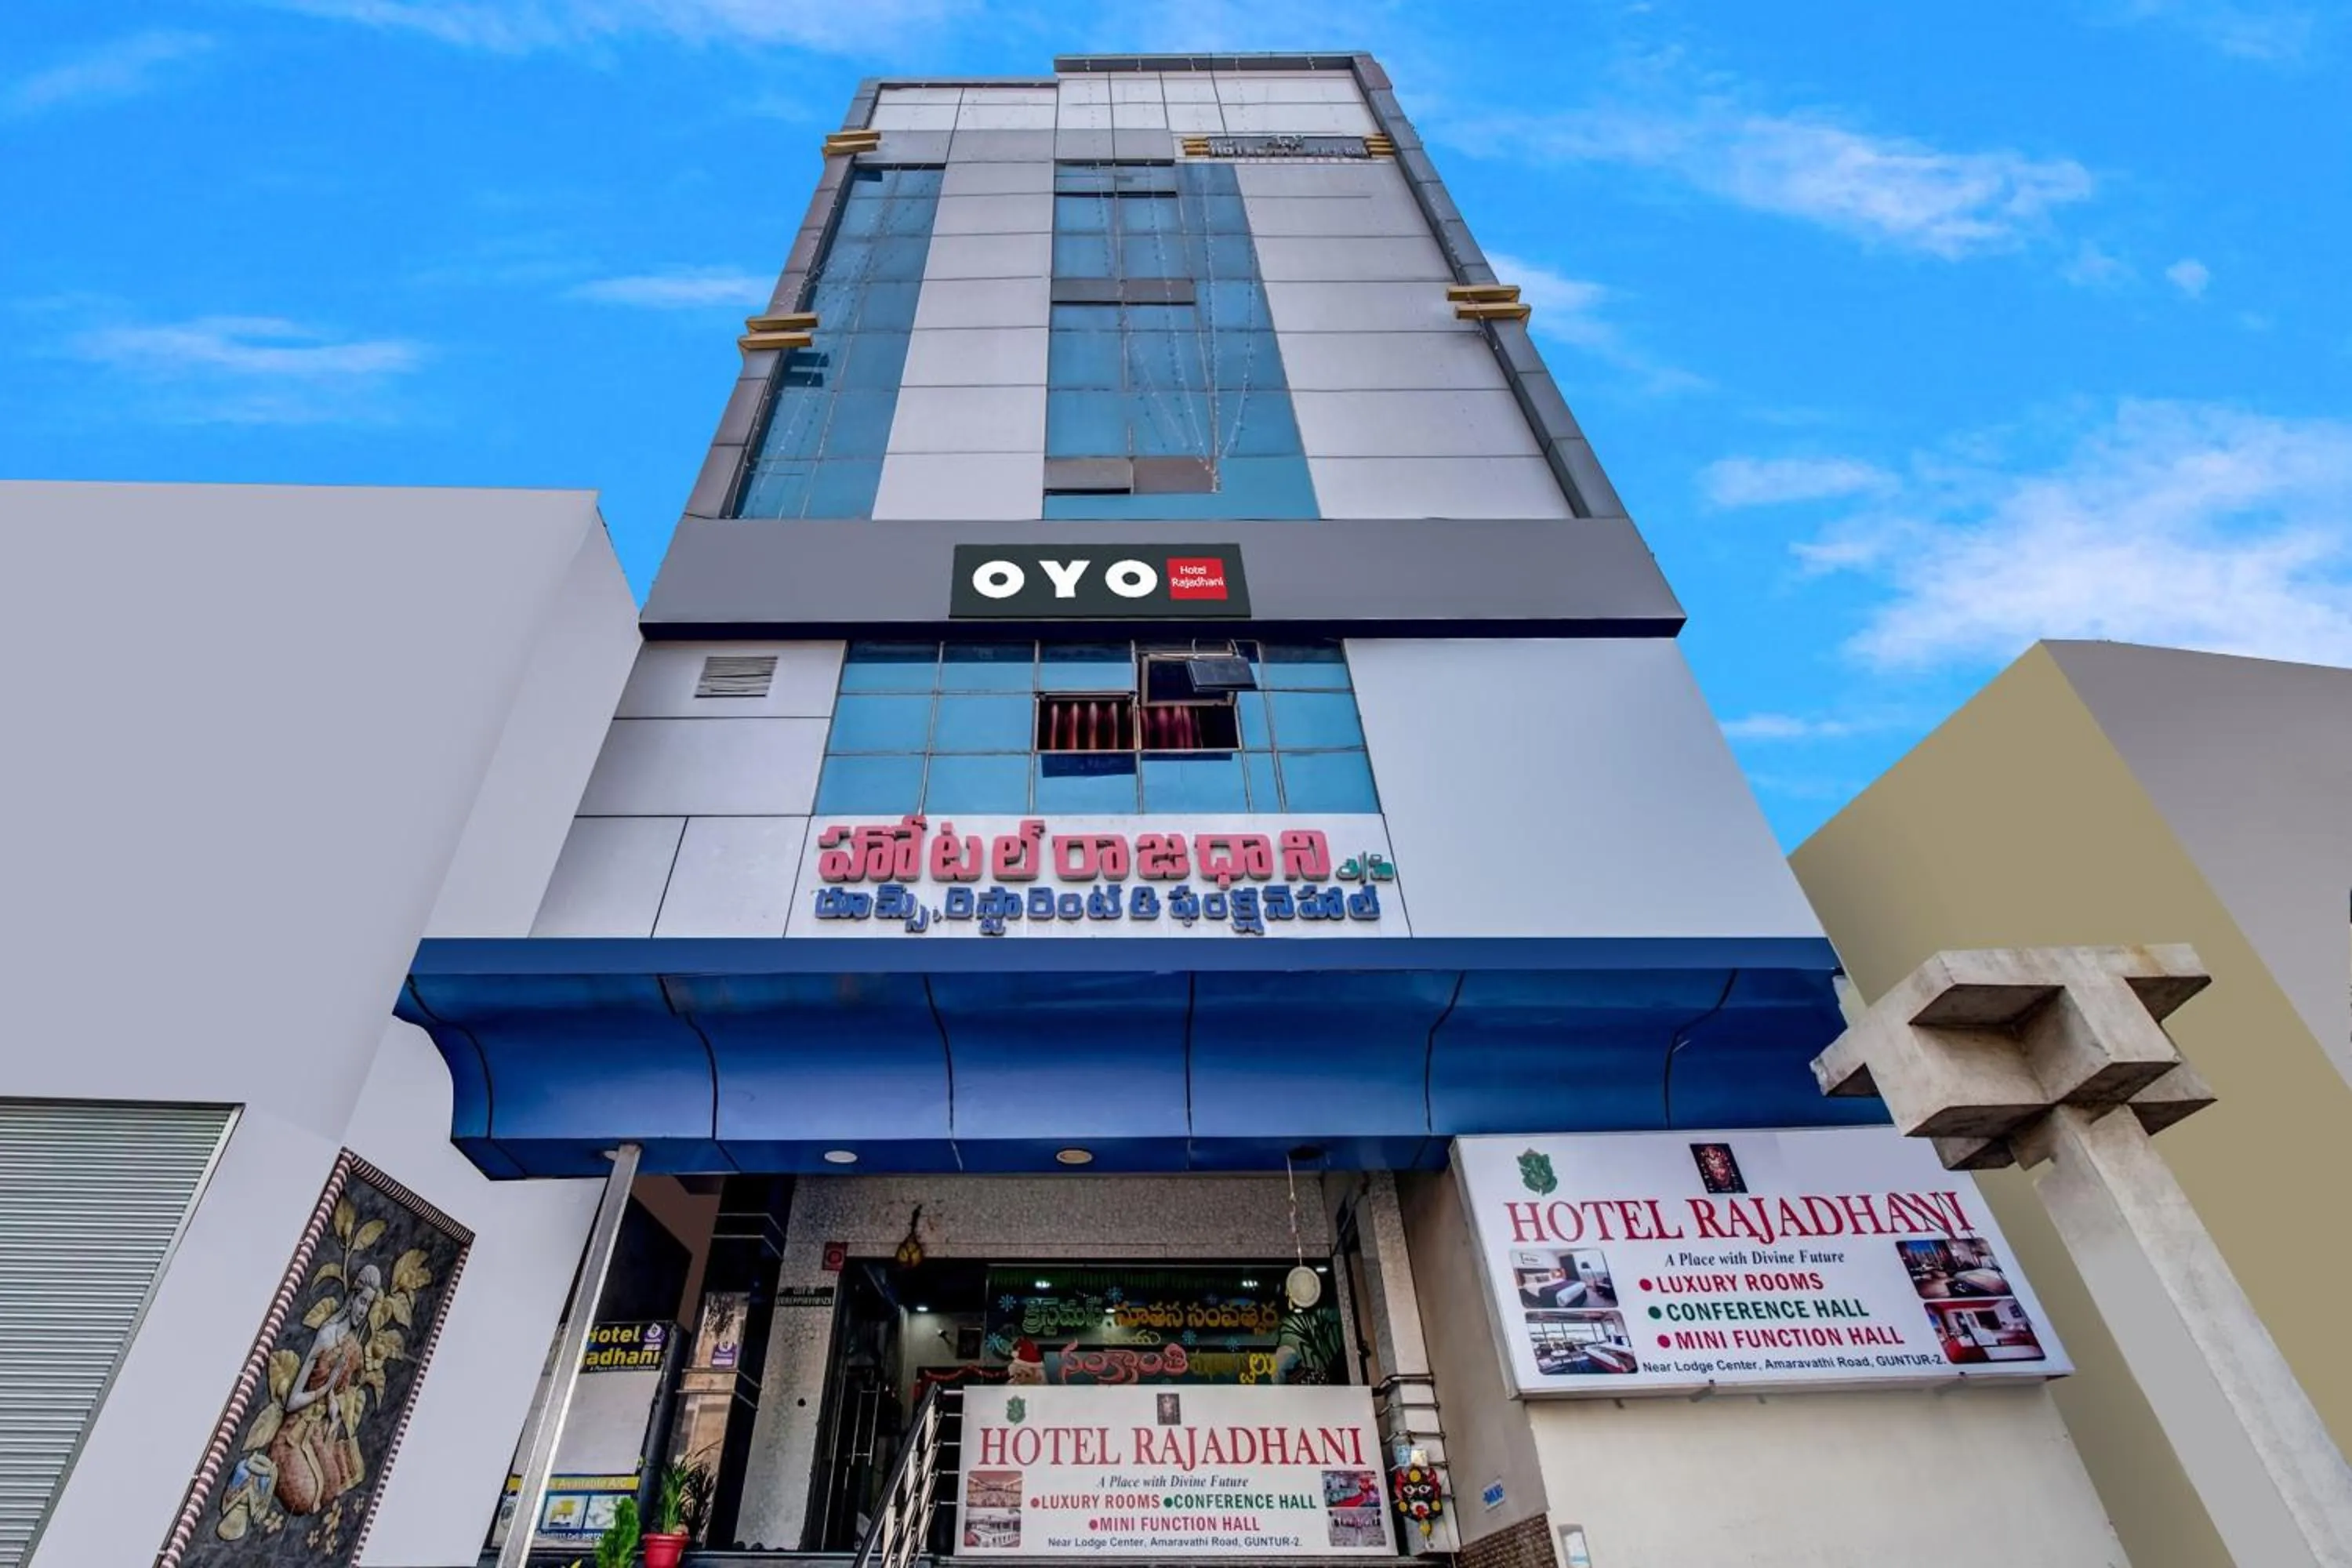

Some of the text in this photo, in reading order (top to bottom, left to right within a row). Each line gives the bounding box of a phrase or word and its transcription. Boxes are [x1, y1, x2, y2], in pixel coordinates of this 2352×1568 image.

[972, 559, 1158, 598] OYO
[1179, 565, 1207, 575] Hotel
[1171, 577, 1225, 588] Rajadhani
[1504, 1191, 1975, 1245] HOTEL RAJADHANI
[1664, 1250, 1845, 1267] A Place with Divine Future
[1656, 1272, 1824, 1294] LUXURY ROOMS
[1666, 1298, 1870, 1322] CONFERENCE HALL
[1675, 1326, 1905, 1350] MINI FUNCTION HALL
[1642, 1355, 1947, 1374] Near Lodge Center, Amaravathi Road, GUNTUR-2.
[978, 1426, 1367, 1472] HOTEL RAJADHANI
[1097, 1474, 1250, 1488] A Place with Divine Future
[1041, 1494, 1317, 1509] LUXURY ROOMS CONFERENCE HALL
[1100, 1516, 1261, 1532] MINI FUNCTION HALL
[1047, 1537, 1072, 1548] Near
[1075, 1537, 1107, 1550] Lodge
[1109, 1537, 1147, 1548] Center,
[1150, 1537, 1209, 1547] Amaravathi
[1214, 1537, 1243, 1548] Road,
